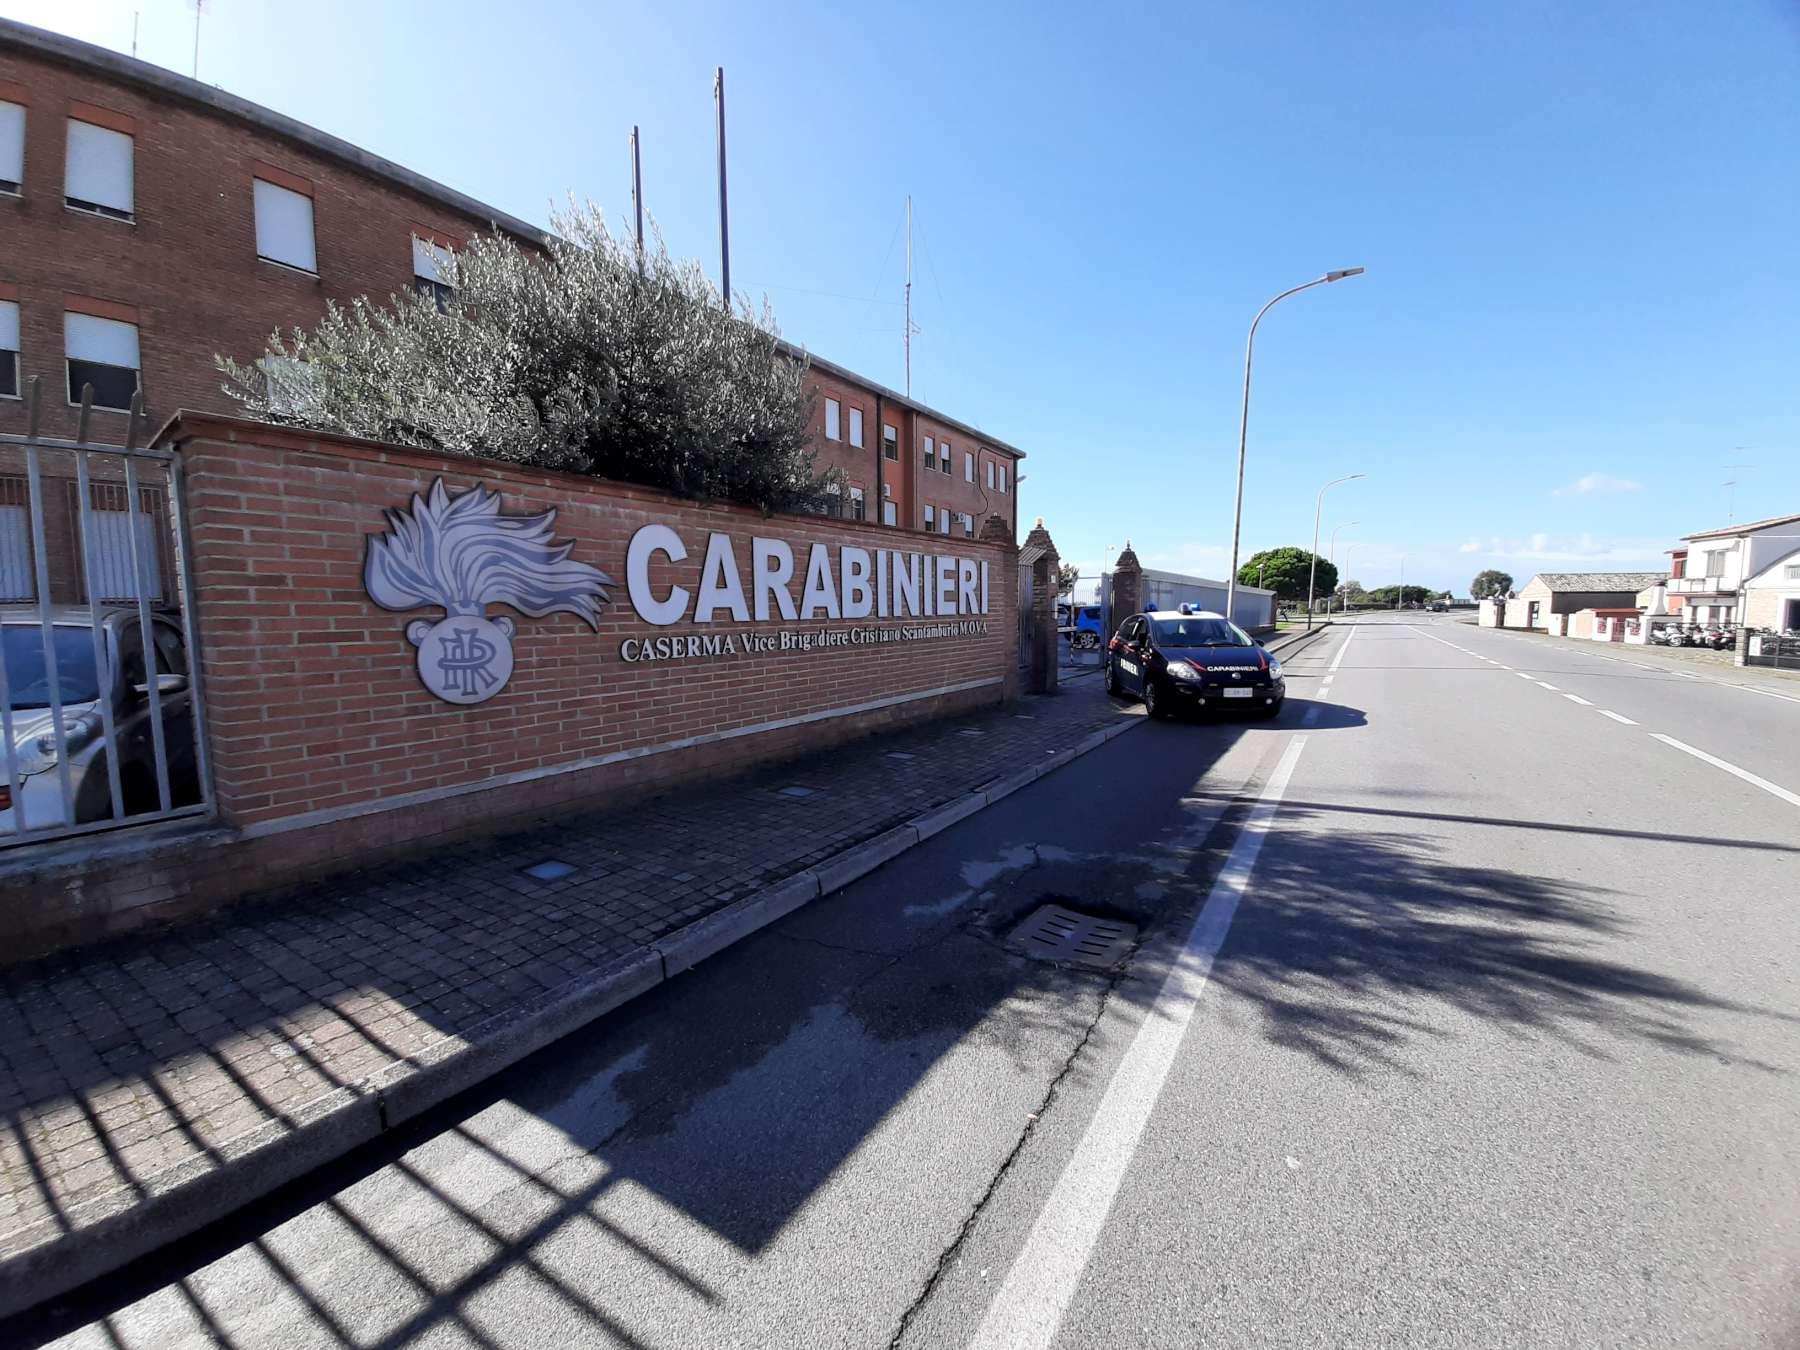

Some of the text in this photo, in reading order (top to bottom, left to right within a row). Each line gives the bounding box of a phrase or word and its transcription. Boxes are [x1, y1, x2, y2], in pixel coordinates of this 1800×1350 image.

[626, 523, 989, 626] CARABINIERI
[621, 634, 736, 662] CASERMA
[740, 632, 780, 653] Vice
[780, 631, 848, 652] Brigadiere
[850, 626, 901, 644] Cristiano
